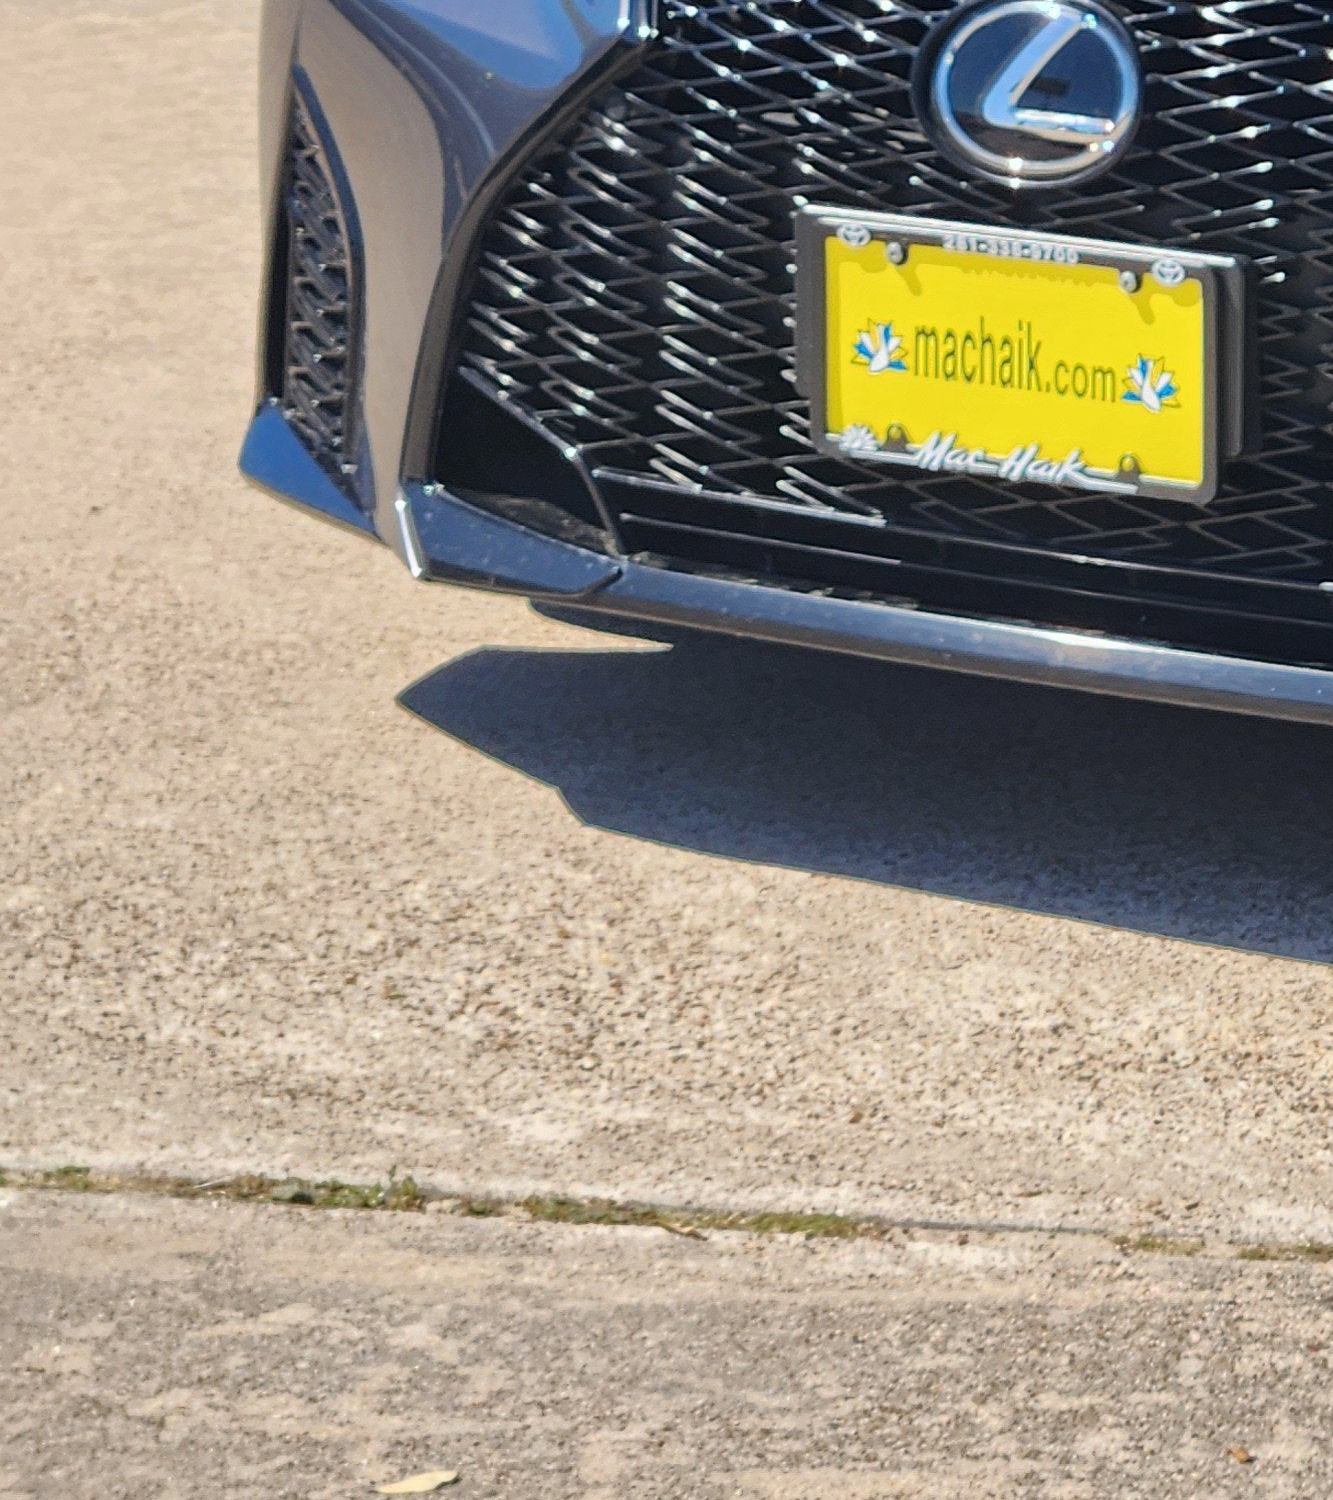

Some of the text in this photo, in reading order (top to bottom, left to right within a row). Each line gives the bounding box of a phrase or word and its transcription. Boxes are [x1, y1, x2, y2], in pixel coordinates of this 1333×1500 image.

[913, 315, 1117, 403] machaik.com
[915, 430, 1098, 486] Mac Haik
